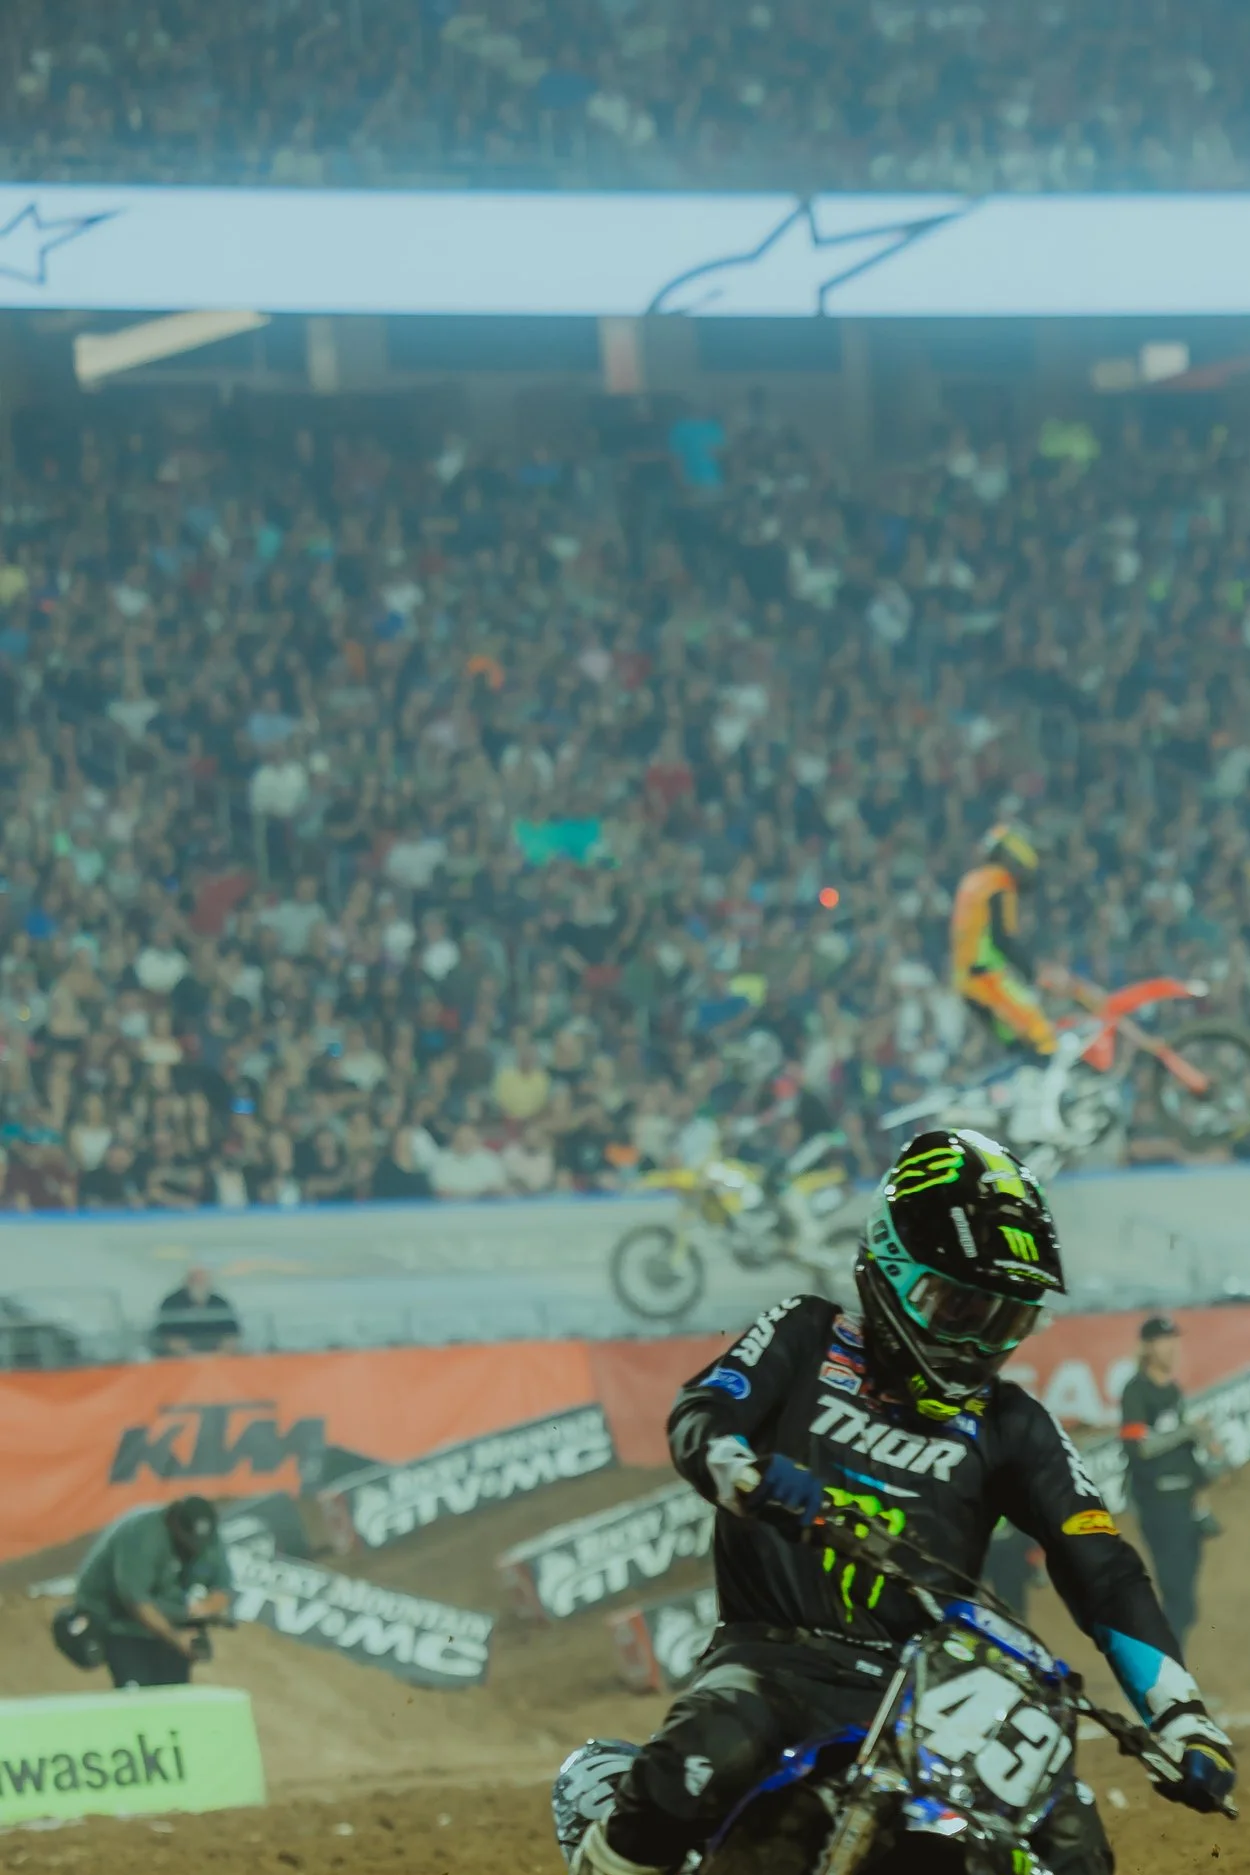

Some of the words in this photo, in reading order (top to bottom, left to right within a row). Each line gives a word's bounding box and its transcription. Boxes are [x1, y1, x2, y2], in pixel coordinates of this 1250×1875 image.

[108, 1400, 327, 1485] KTM
[809, 1393, 968, 1483] THOR
[0, 1730, 187, 1799] wasaki
[915, 1666, 1063, 1808] 43
